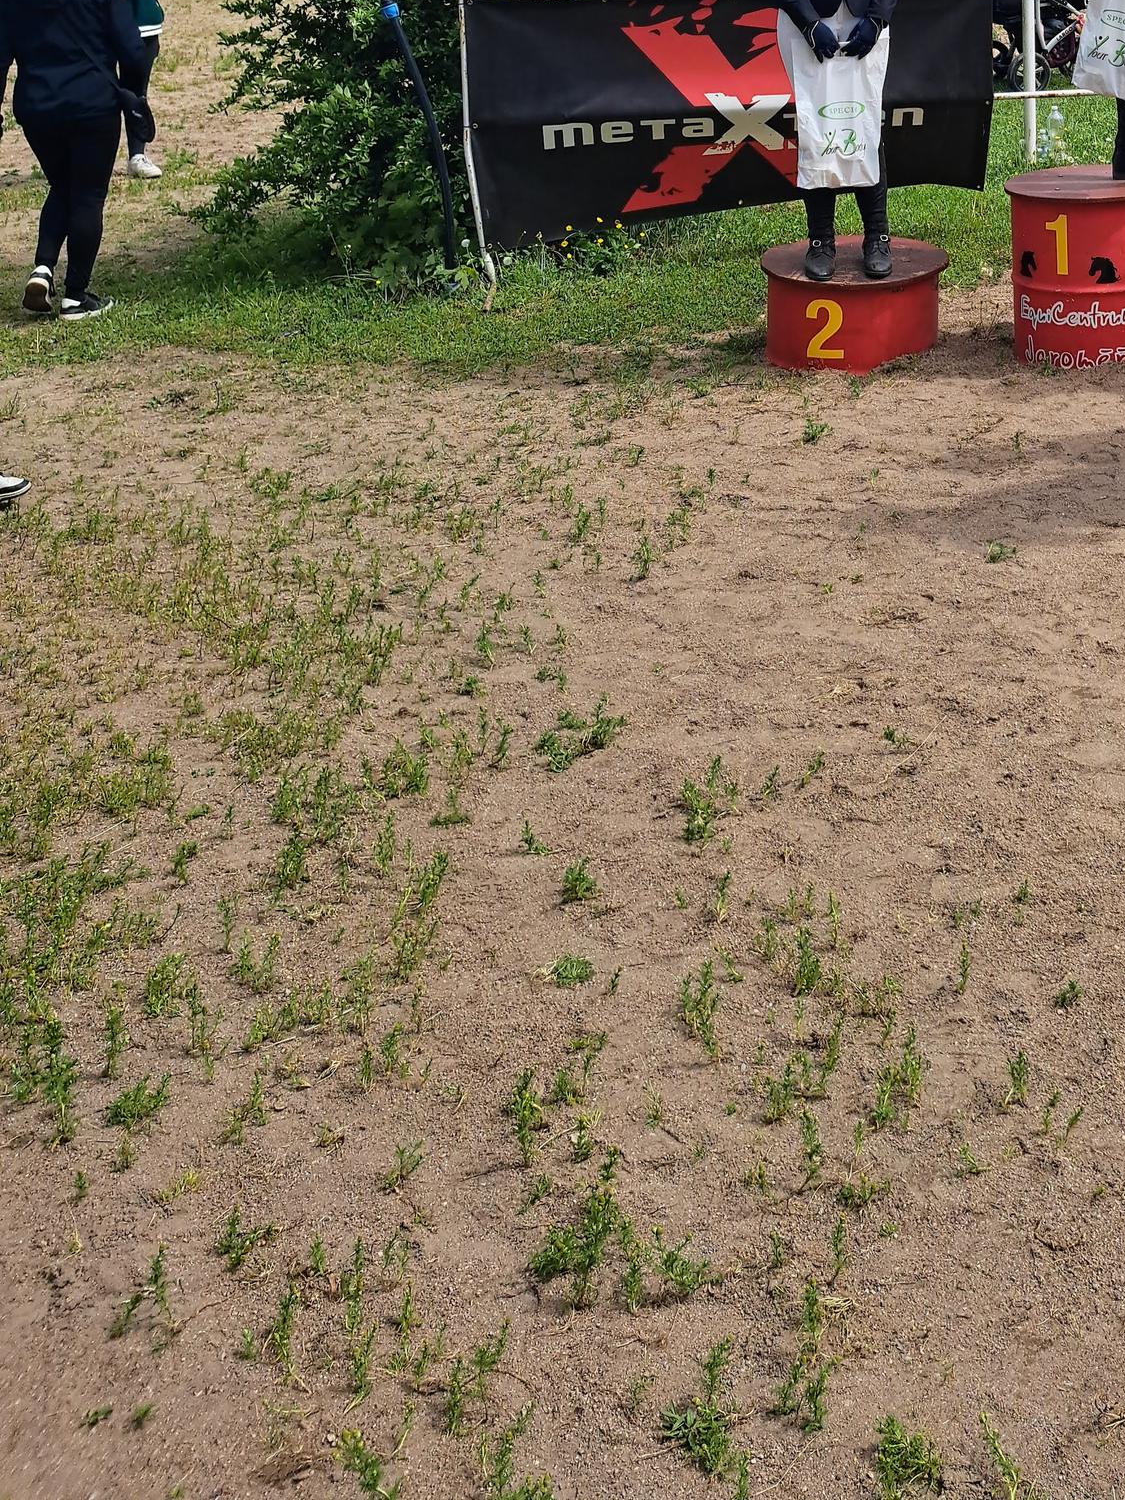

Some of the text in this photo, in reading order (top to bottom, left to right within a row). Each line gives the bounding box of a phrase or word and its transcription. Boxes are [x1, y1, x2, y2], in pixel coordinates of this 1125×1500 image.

[1087, 35, 1109, 61] Your
[1045, 213, 1069, 276] 1
[805, 298, 845, 359] 2
